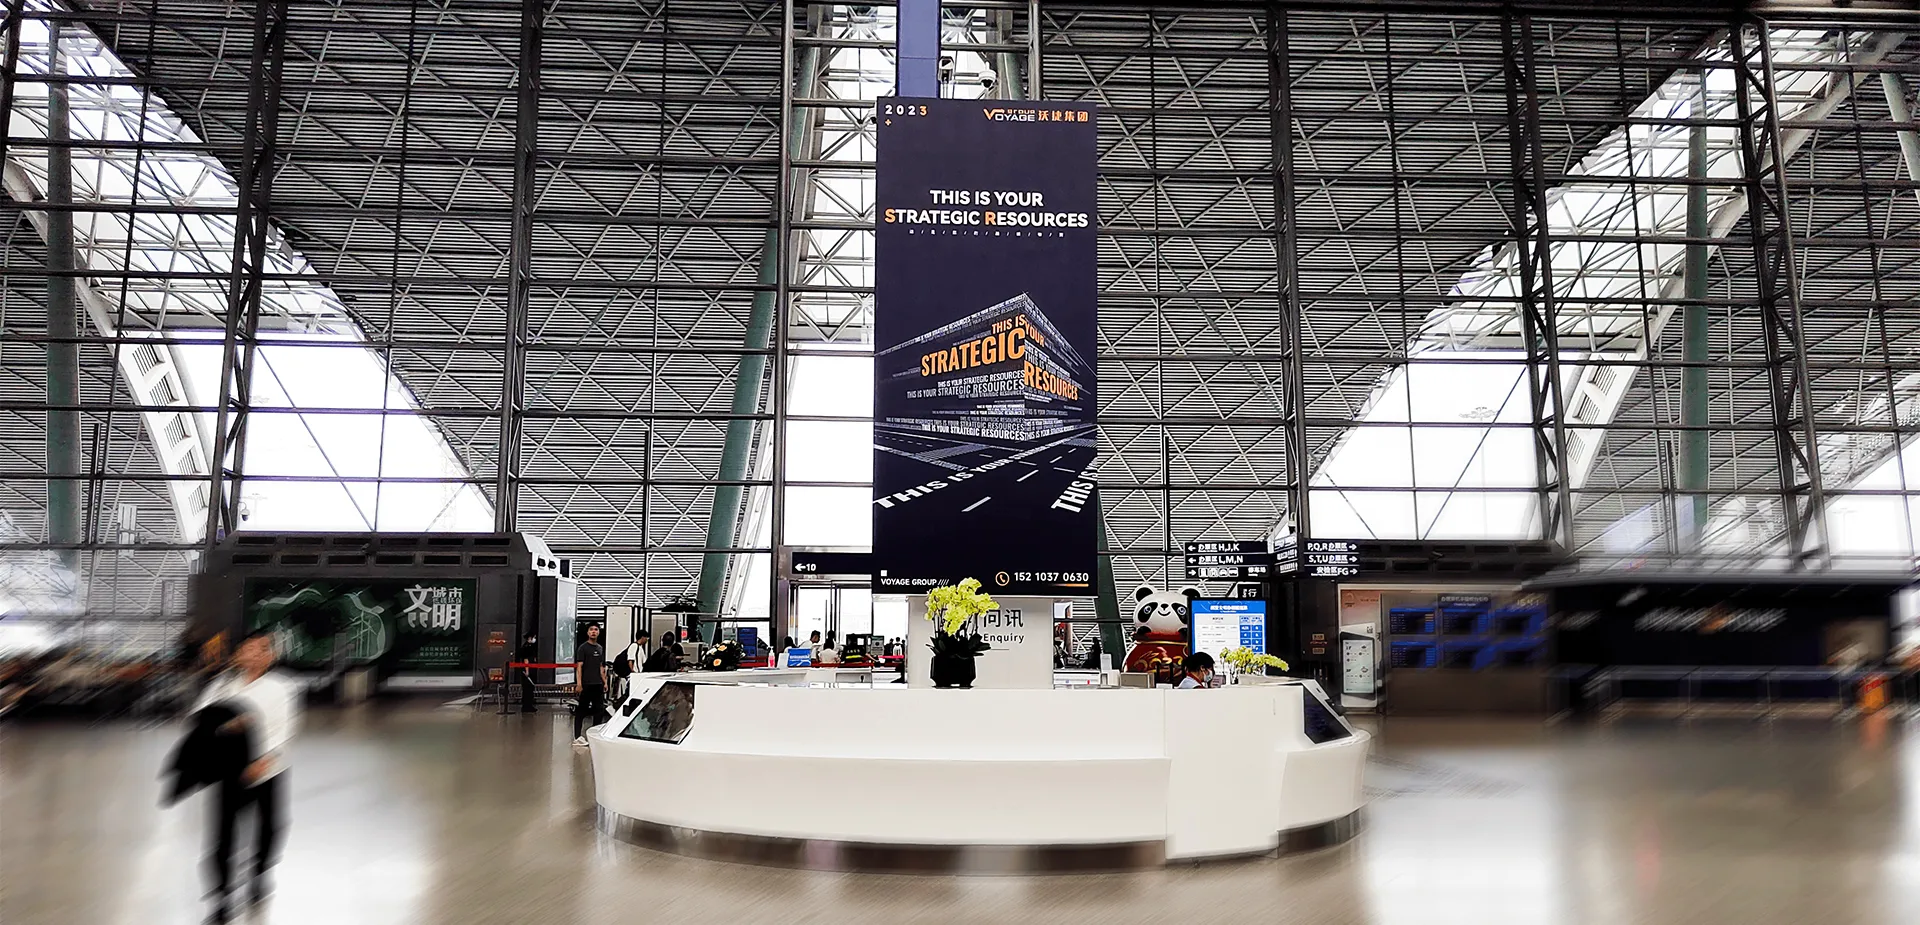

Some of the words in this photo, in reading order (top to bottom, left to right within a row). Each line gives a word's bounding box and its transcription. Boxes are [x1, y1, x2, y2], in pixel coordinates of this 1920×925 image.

[885, 104, 928, 116] 2023
[930, 190, 970, 205] THIS
[975, 191, 990, 205] IS
[994, 191, 1044, 207] YOUR
[884, 209, 980, 225] STRATEGIC
[985, 211, 1088, 227] RESOURCES
[991, 318, 1012, 335] THIS
[1015, 314, 1026, 327] IS
[1024, 319, 1044, 347] YOUR
[921, 327, 1026, 377] STRATEGIC
[1024, 360, 1078, 401] RESOURCES
[990, 370, 1025, 381] RESOURCES
[938, 384, 971, 396] STRATEGIC
[973, 379, 1025, 393] RESOURCES
[981, 429, 1025, 440] RESOURCES
[873, 481, 948, 508] THIS
[947, 472, 974, 482] IS
[970, 459, 1013, 472] YOUR
[1051, 481, 1094, 513] THIS
[806, 563, 816, 571] 10
[1014, 572, 1031, 581] 152
[1035, 572, 1059, 582] 1037
[1063, 573, 1089, 583] 0630
[432, 587, 463, 598] 城市
[984, 609, 1023, 628] 问讯
[984, 633, 1024, 644] Enquiry
